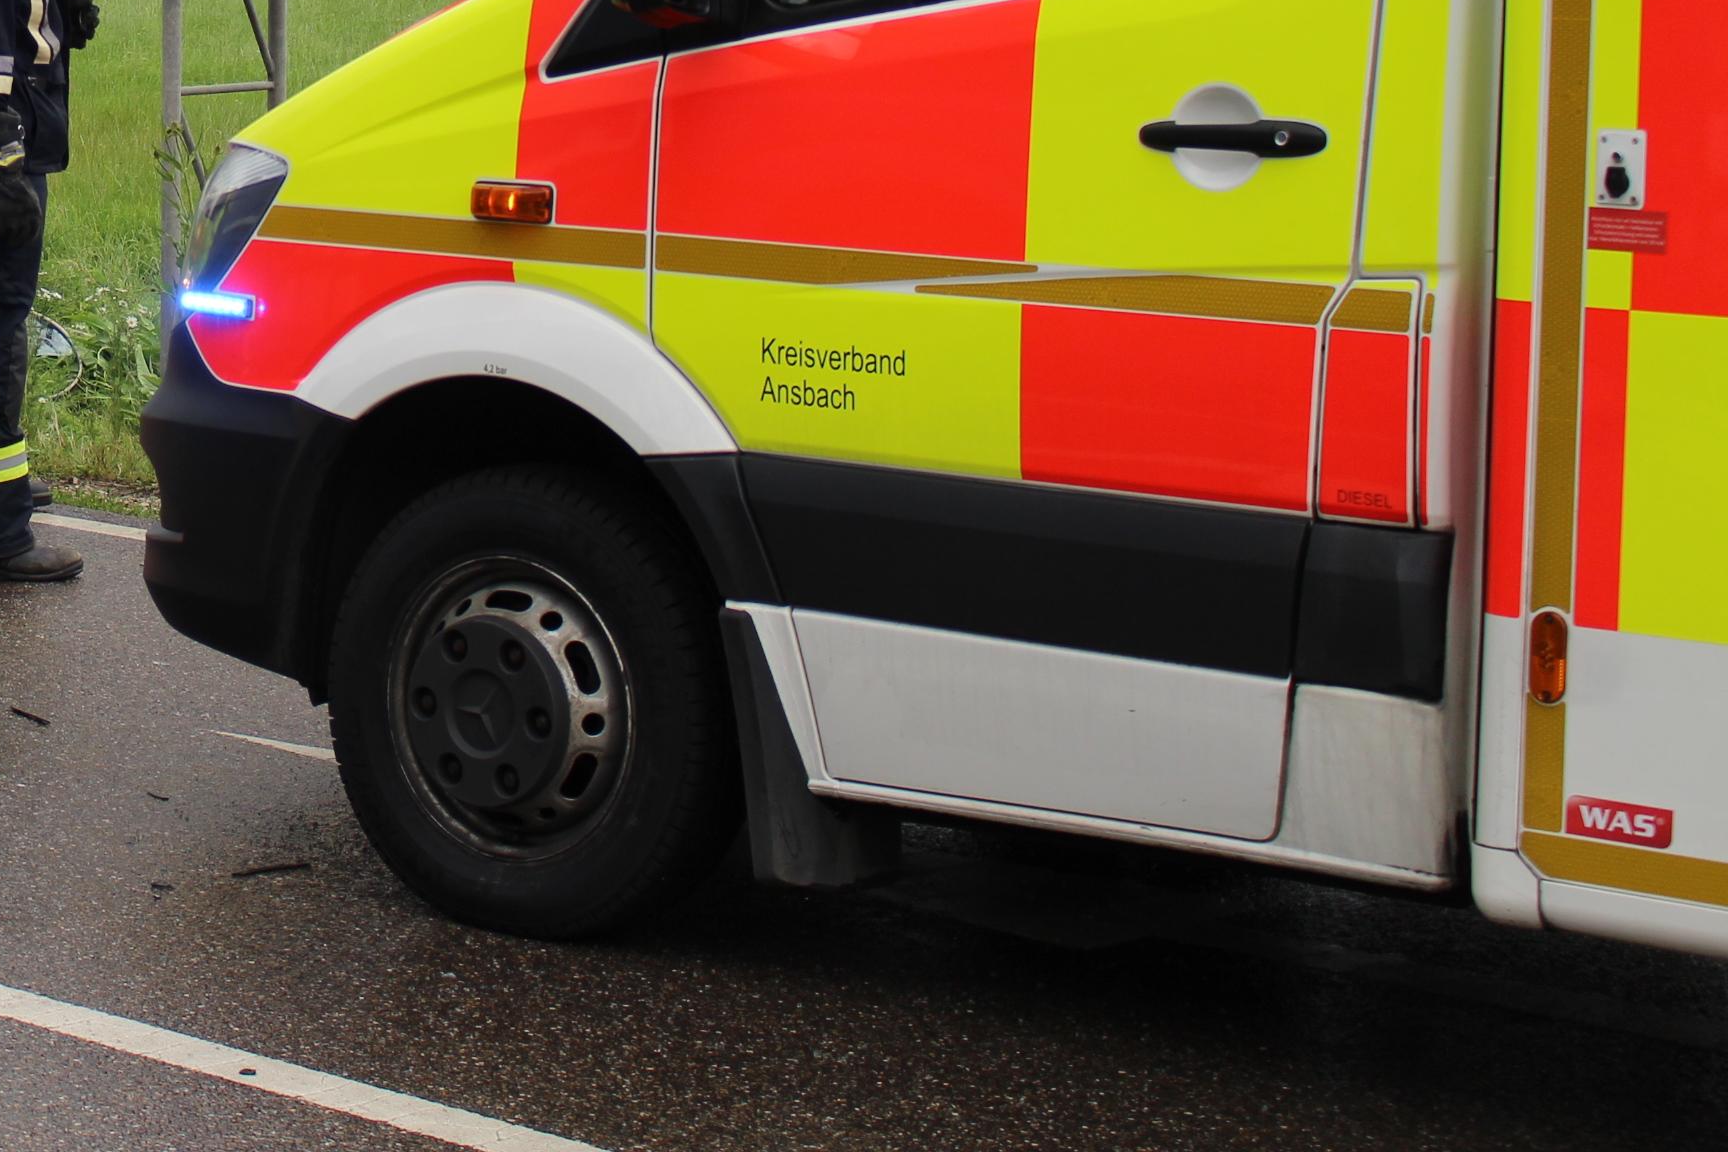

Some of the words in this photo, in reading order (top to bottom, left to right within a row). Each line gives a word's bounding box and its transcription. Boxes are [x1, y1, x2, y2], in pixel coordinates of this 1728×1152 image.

[761, 337, 906, 376] Kreisverband
[760, 376, 855, 410] Ansbach
[1337, 489, 1393, 509] DIESEL
[1578, 804, 1657, 839] WAS
